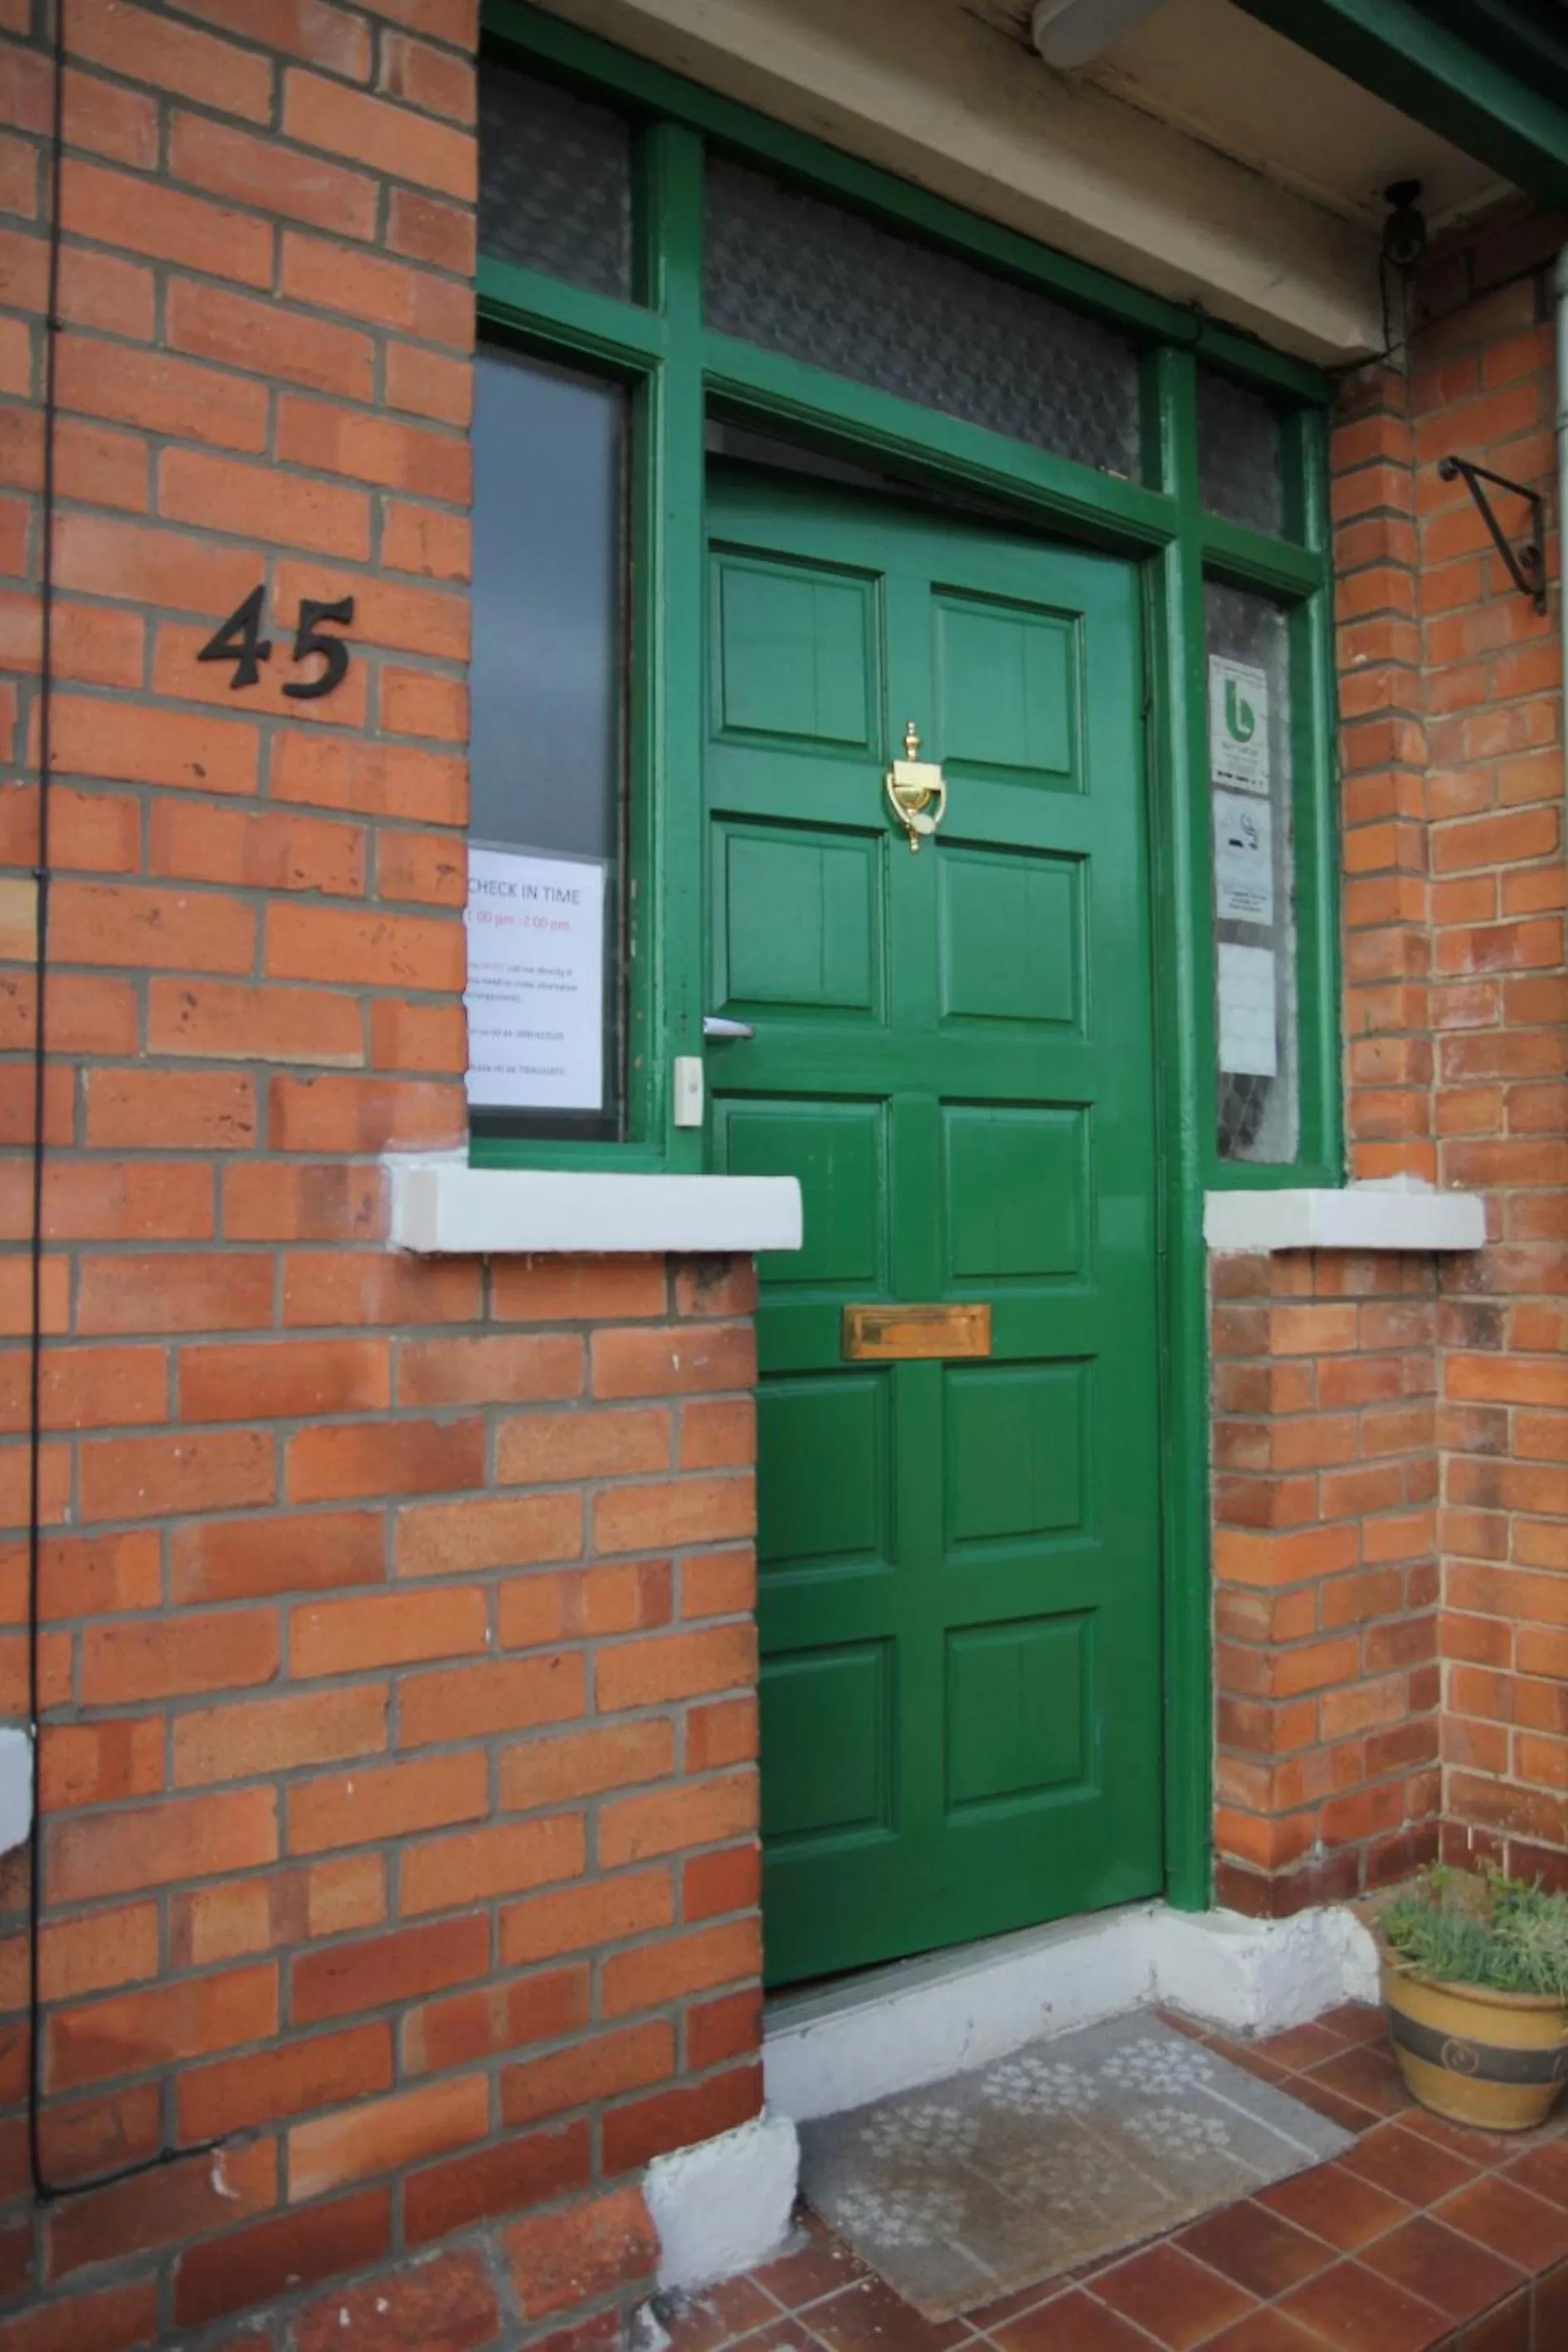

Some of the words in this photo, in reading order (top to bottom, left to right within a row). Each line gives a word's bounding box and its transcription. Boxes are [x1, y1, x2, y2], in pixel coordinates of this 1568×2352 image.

[196, 583, 355, 699] 45
[468, 878, 519, 899] CHECK
[521, 883, 538, 901] IN
[543, 884, 582, 905] TIME
